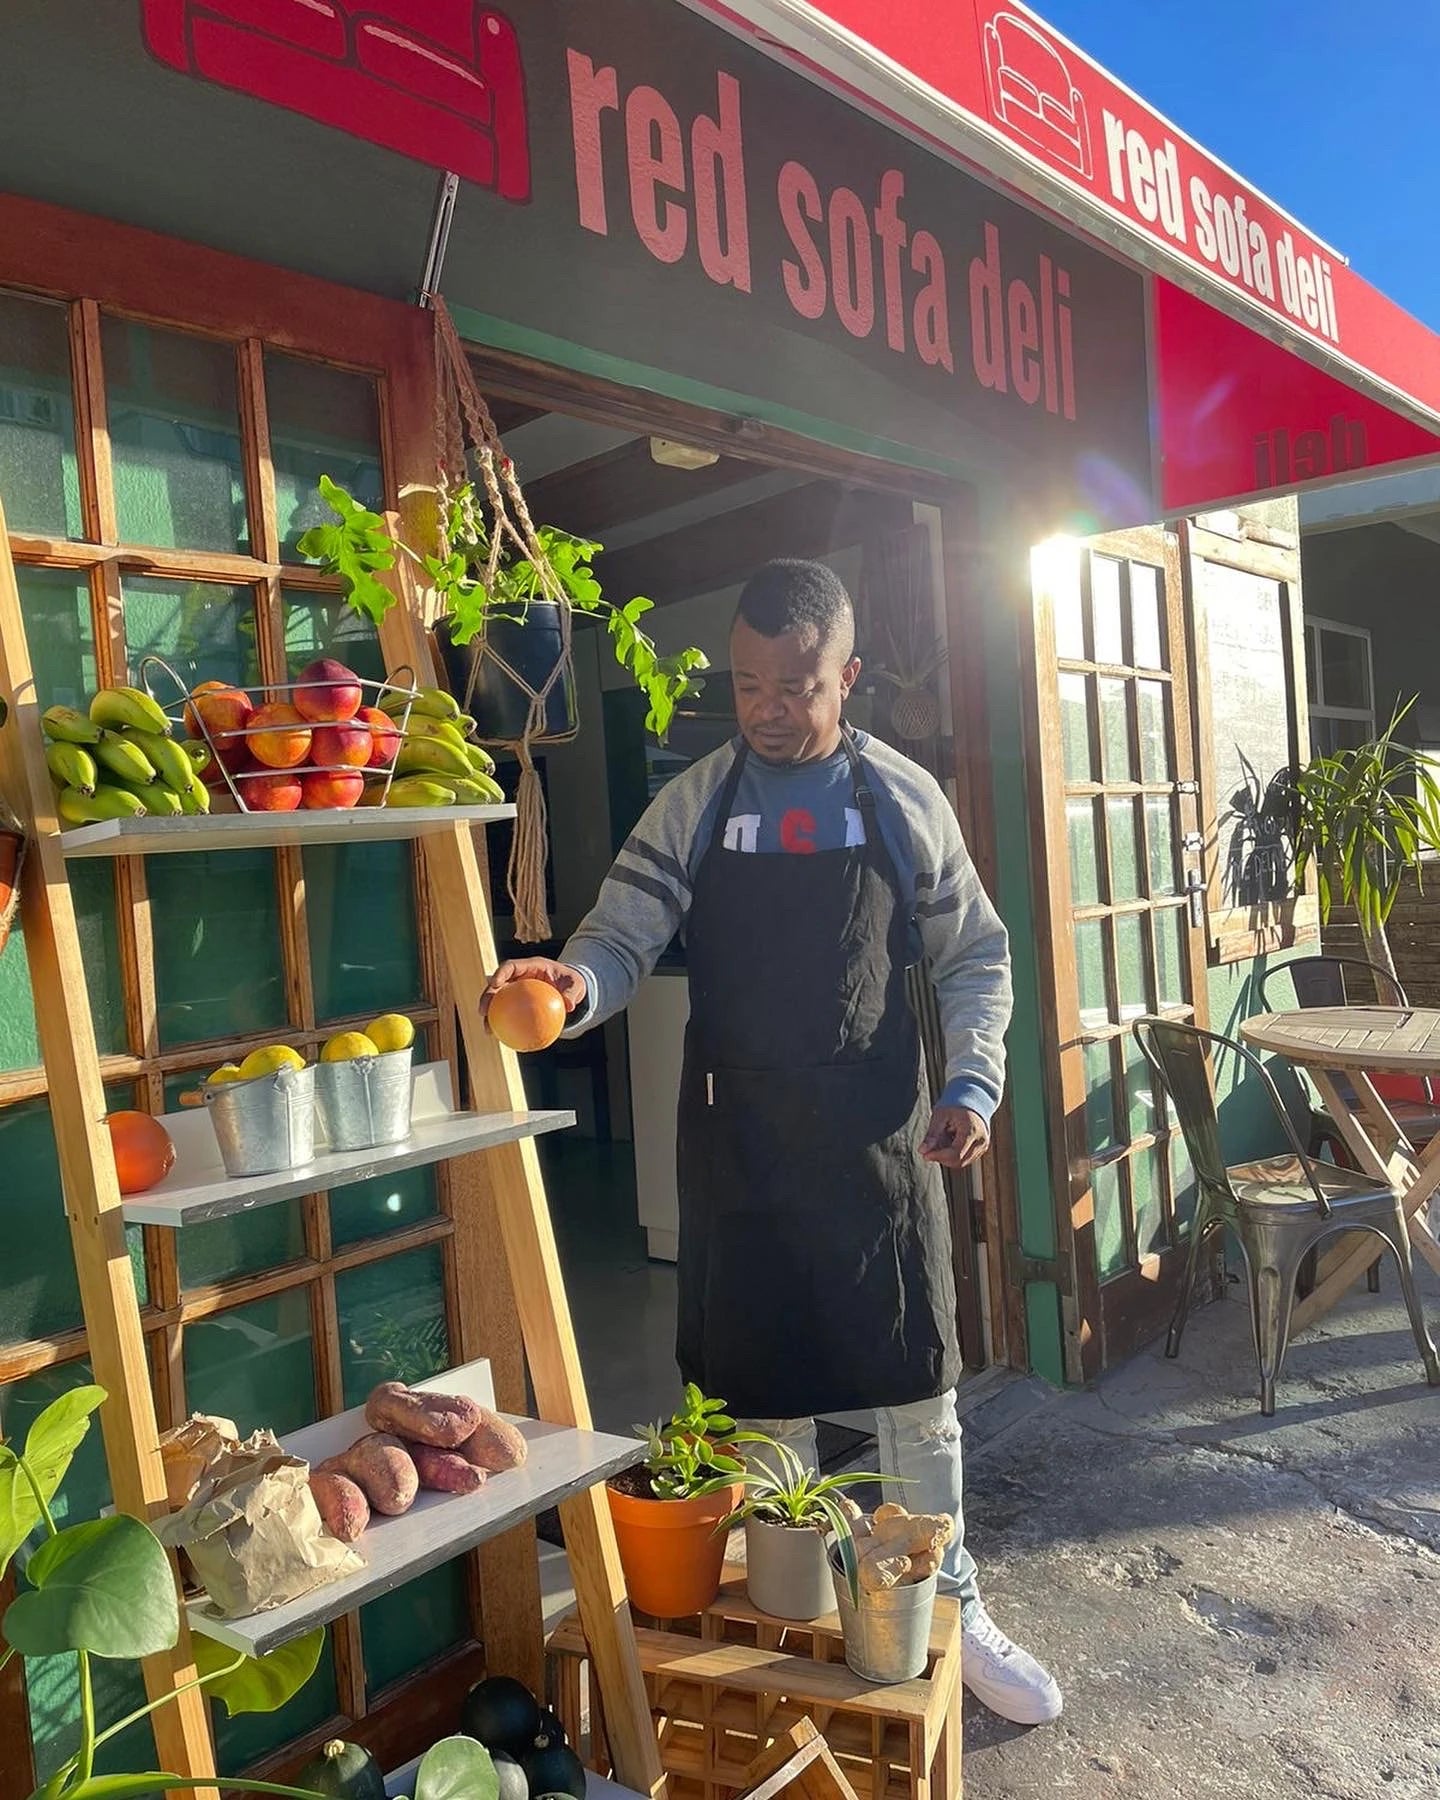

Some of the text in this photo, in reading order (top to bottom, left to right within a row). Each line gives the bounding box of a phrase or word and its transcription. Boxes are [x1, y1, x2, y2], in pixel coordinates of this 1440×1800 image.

[566, 47, 1076, 421] red sofa deli
[1102, 108, 1340, 343] red sofa deli
